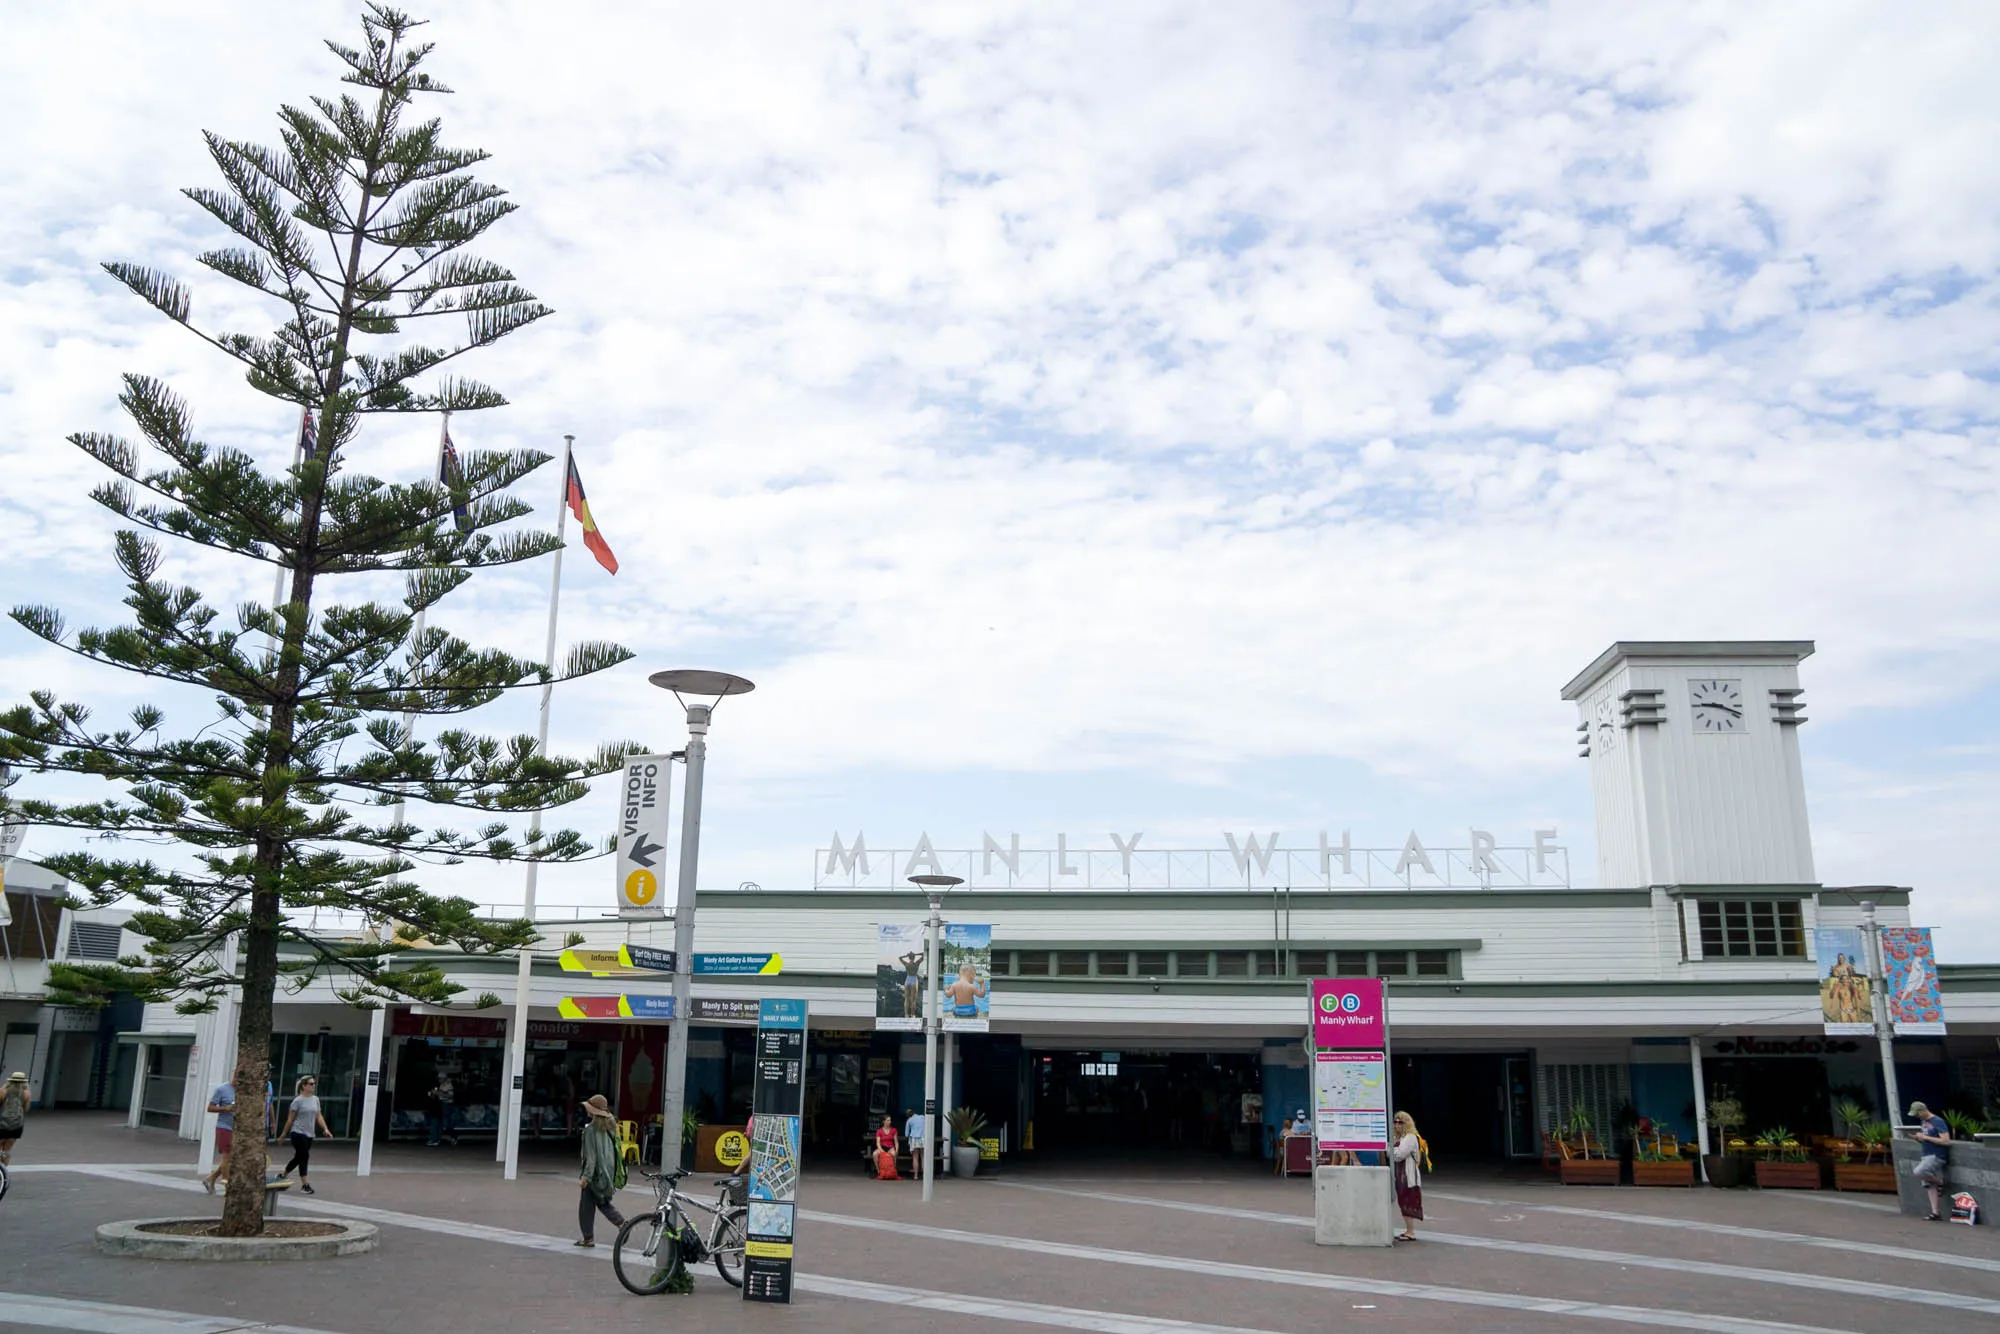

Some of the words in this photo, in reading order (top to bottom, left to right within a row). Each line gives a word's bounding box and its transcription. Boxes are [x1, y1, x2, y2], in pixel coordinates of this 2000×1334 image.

[642, 763, 658, 808] INFO
[624, 764, 643, 838] VISITOR
[825, 829, 1144, 878] MANLY
[1224, 828, 1558, 878] WHARF
[652, 951, 662, 961] FREE
[701, 1002, 721, 1012] Manly
[722, 1002, 729, 1010] to
[729, 1002, 743, 1012] Spit
[743, 1003, 760, 1011] walk
[1326, 997, 1333, 1009] F
[1347, 997, 1355, 1009] B
[1320, 1016, 1346, 1026] Manly
[1346, 1016, 1374, 1025] Wharf
[1734, 1035, 1840, 1055] Nando's
